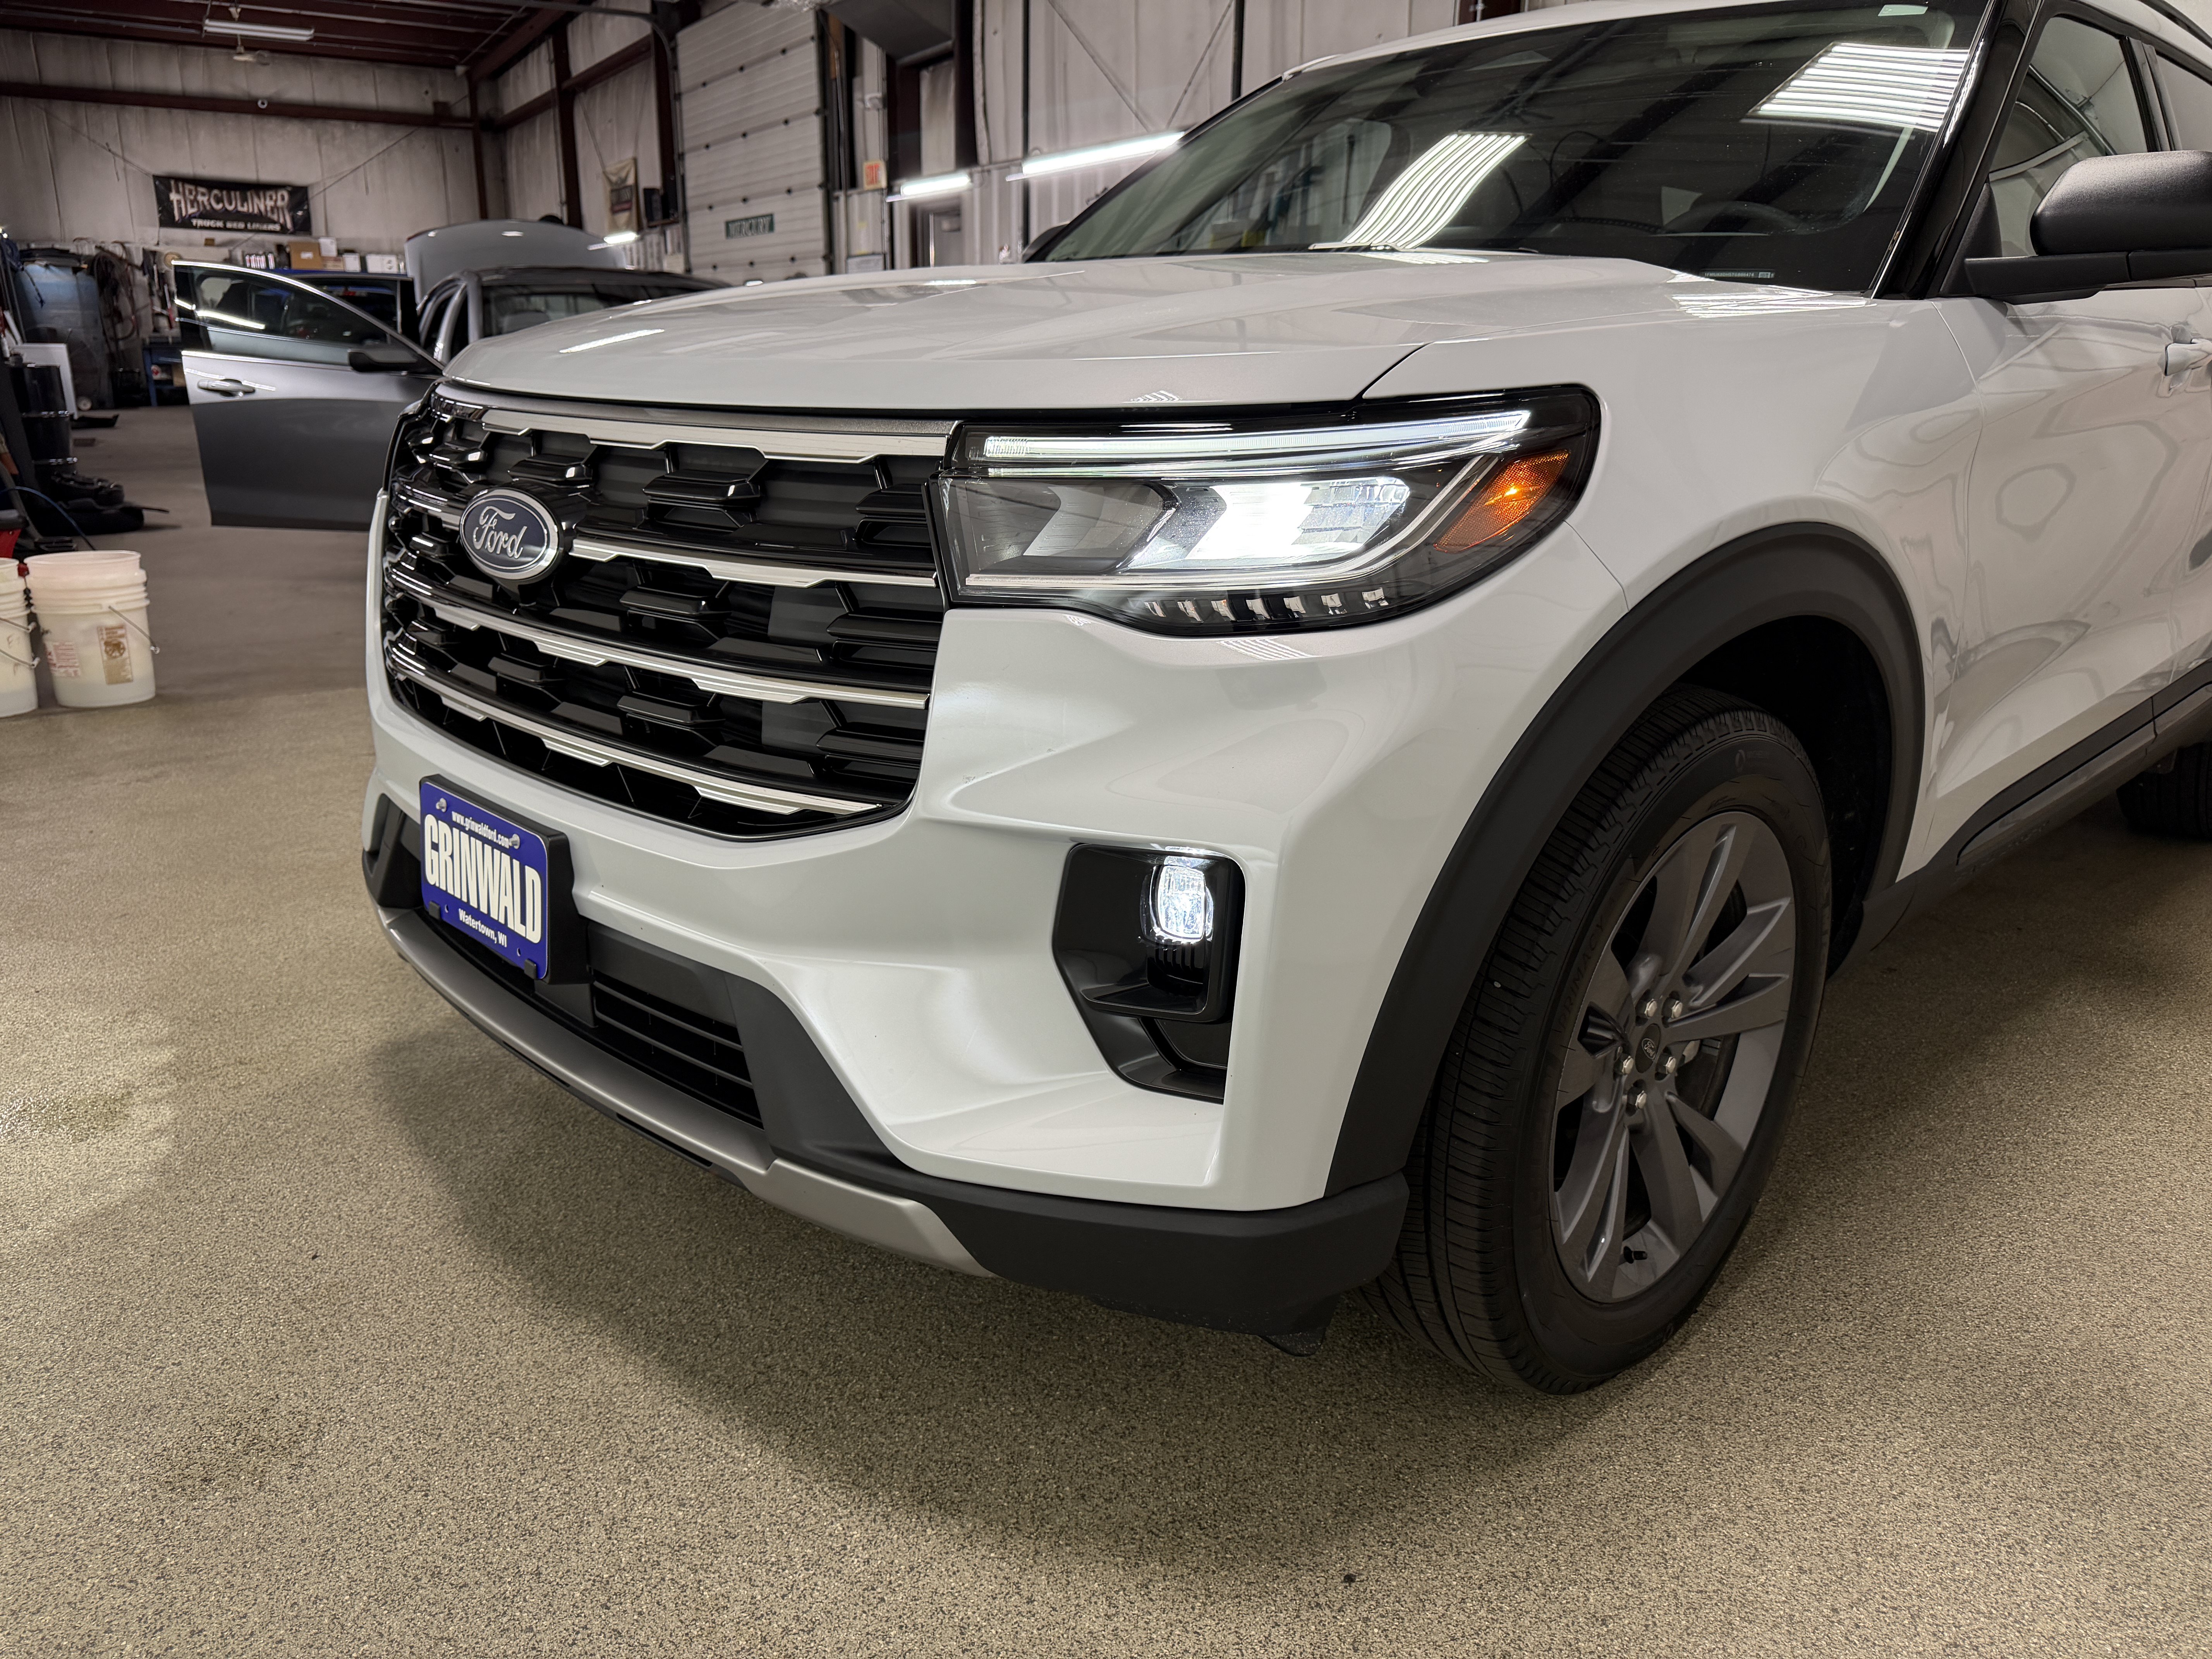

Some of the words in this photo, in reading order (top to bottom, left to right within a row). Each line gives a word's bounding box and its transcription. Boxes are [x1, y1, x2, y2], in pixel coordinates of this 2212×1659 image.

[169, 179, 294, 234] HERCULINER
[191, 219, 224, 228] TRUCK
[473, 506, 527, 558] Ford
[452, 811, 510, 849] www.grinwaldford.com
[424, 814, 541, 944] GRINWALD
[459, 908, 497, 944] Watertown,
[498, 931, 507, 948] WI
[1644, 1041, 1655, 1057] Ford
